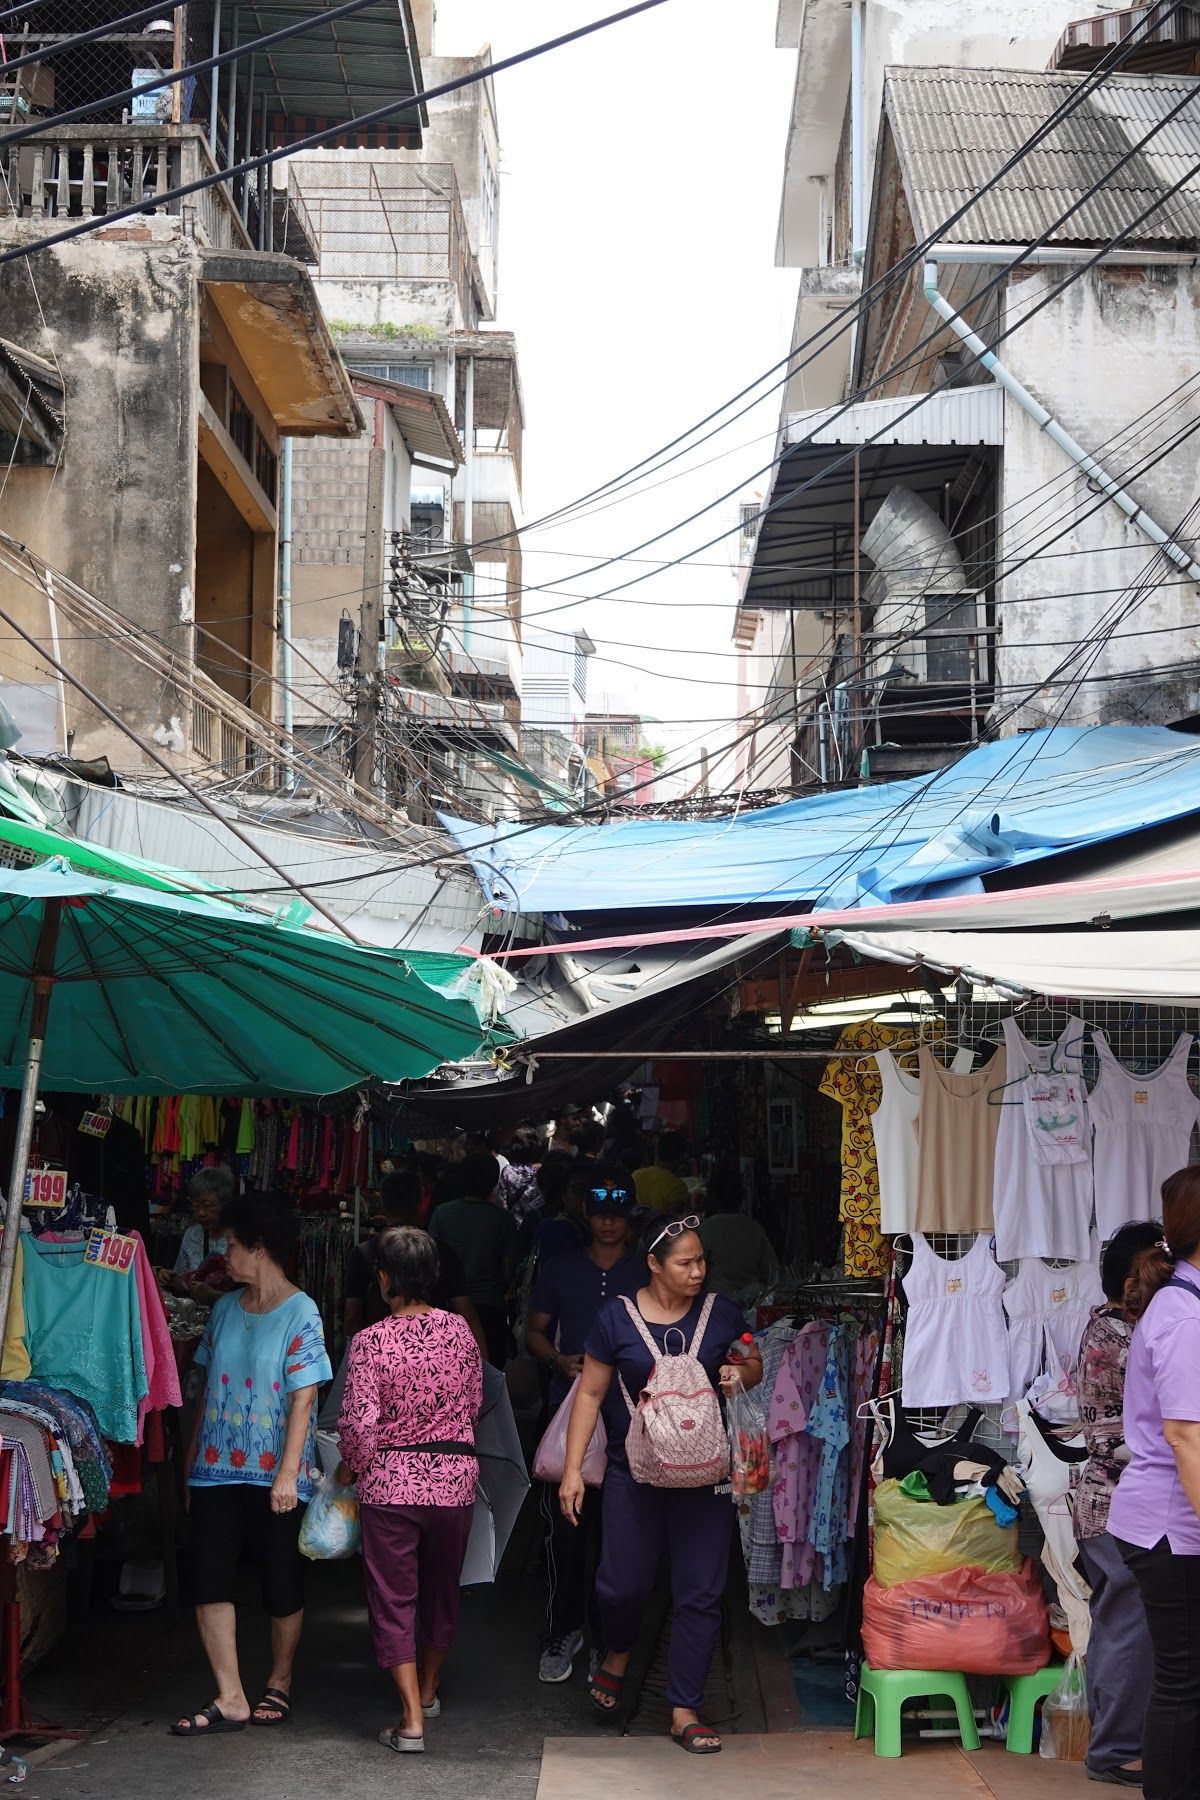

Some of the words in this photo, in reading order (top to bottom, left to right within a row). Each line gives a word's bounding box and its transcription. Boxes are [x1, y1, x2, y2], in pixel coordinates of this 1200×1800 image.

[91, 1115, 110, 1132] 400
[32, 1174, 65, 1202] 199
[86, 1231, 104, 1262] SALE
[100, 1236, 134, 1268] 199
